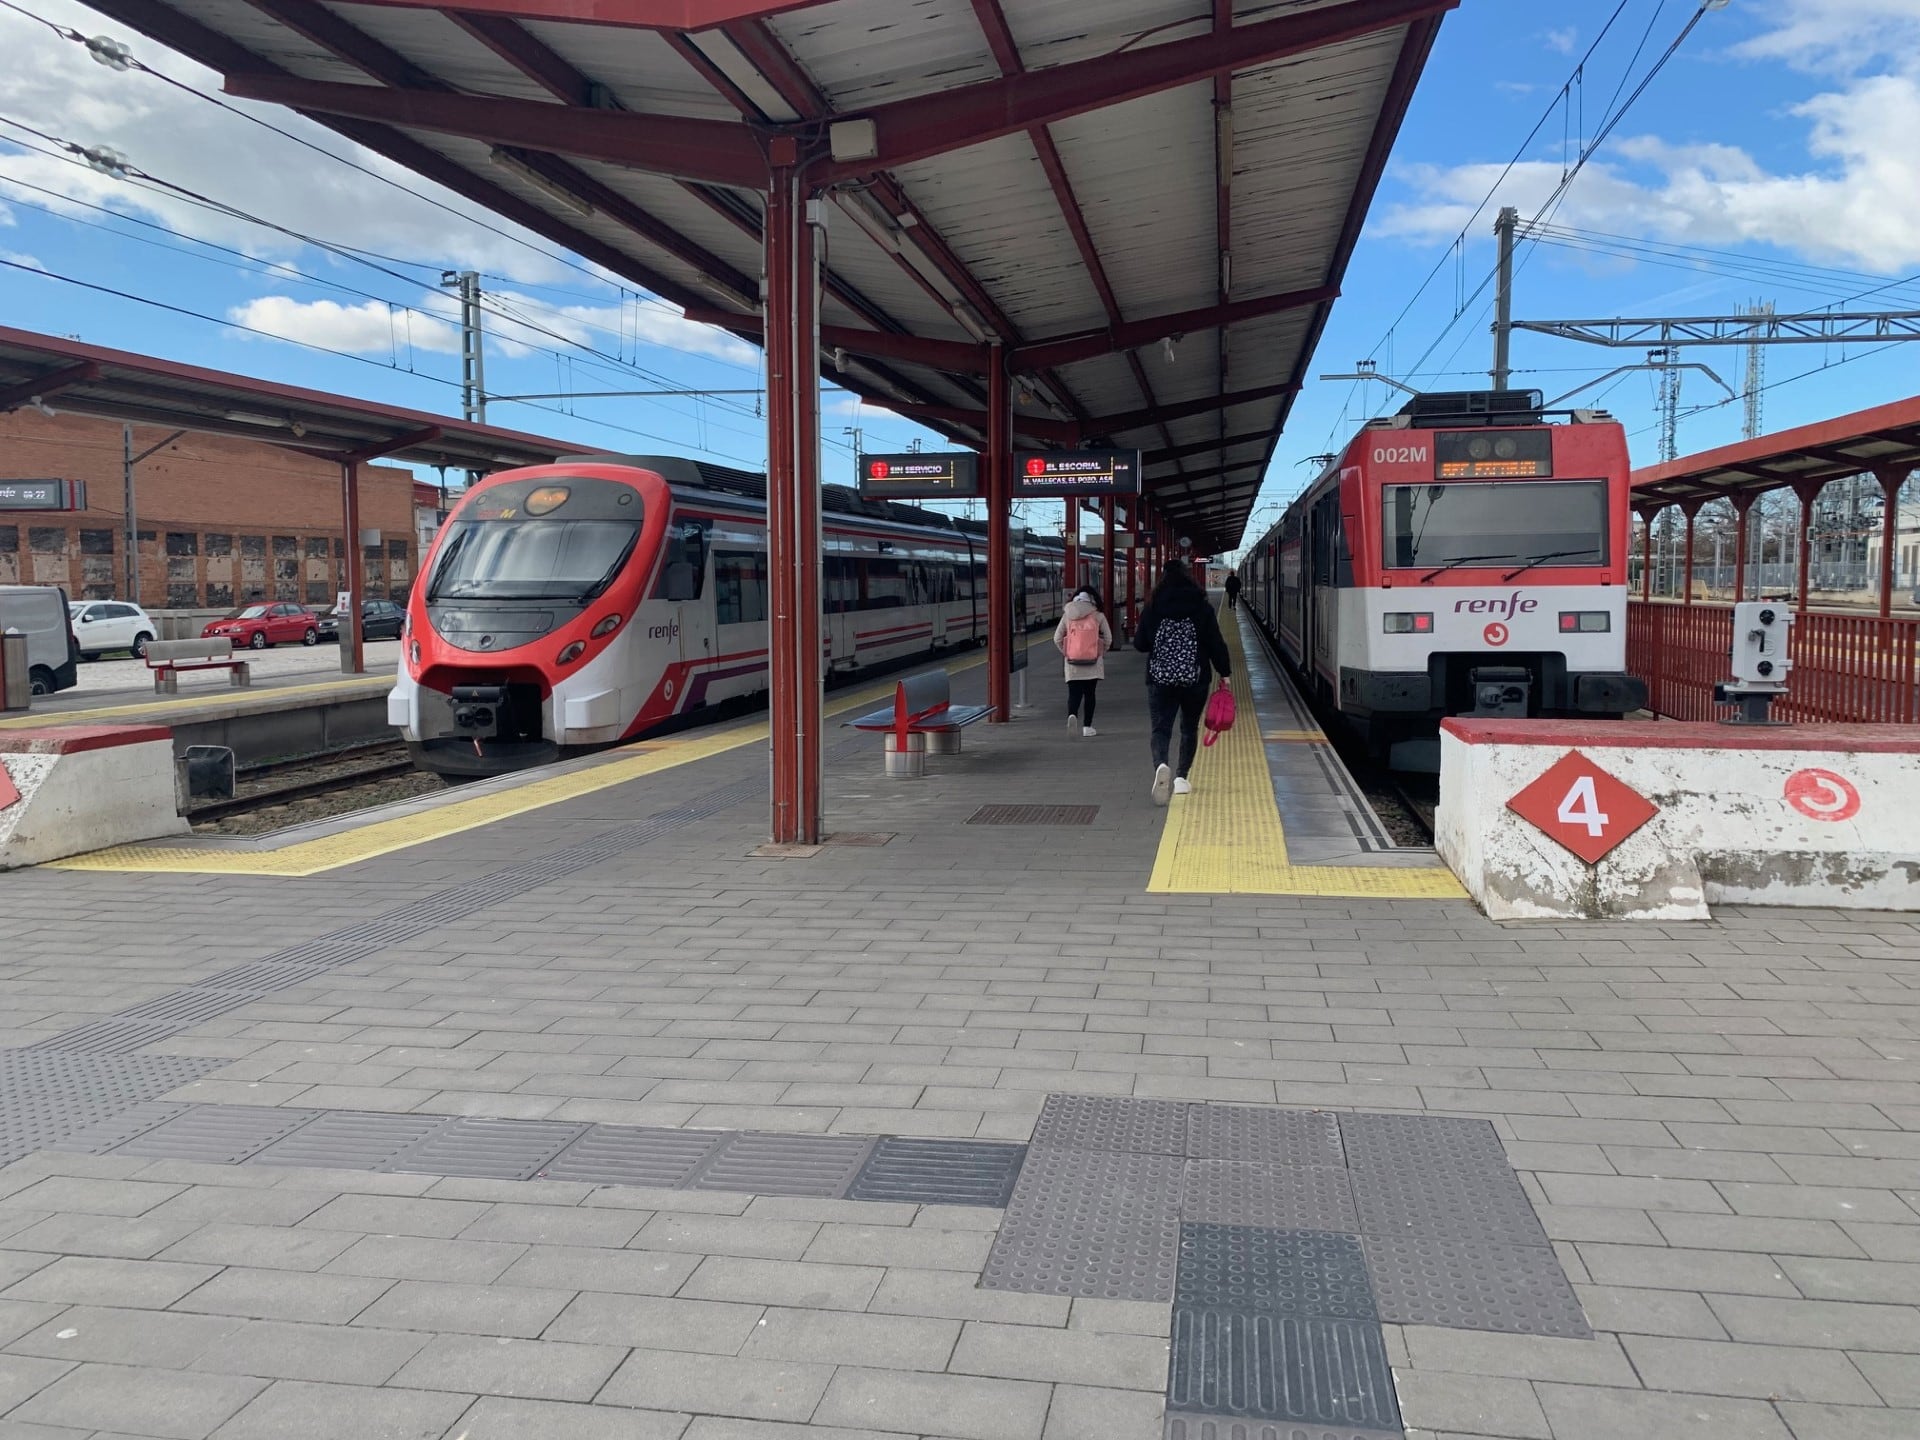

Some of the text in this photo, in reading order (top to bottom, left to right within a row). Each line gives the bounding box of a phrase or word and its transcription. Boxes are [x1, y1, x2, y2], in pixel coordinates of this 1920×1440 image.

[1059, 462, 1100, 470] ESCORIAL
[1373, 447, 1427, 464] 002M
[905, 465, 942, 473] SERVICIO
[1454, 590, 1538, 621] renfe
[648, 617, 679, 645] renfe
[1556, 775, 1610, 838] 4
